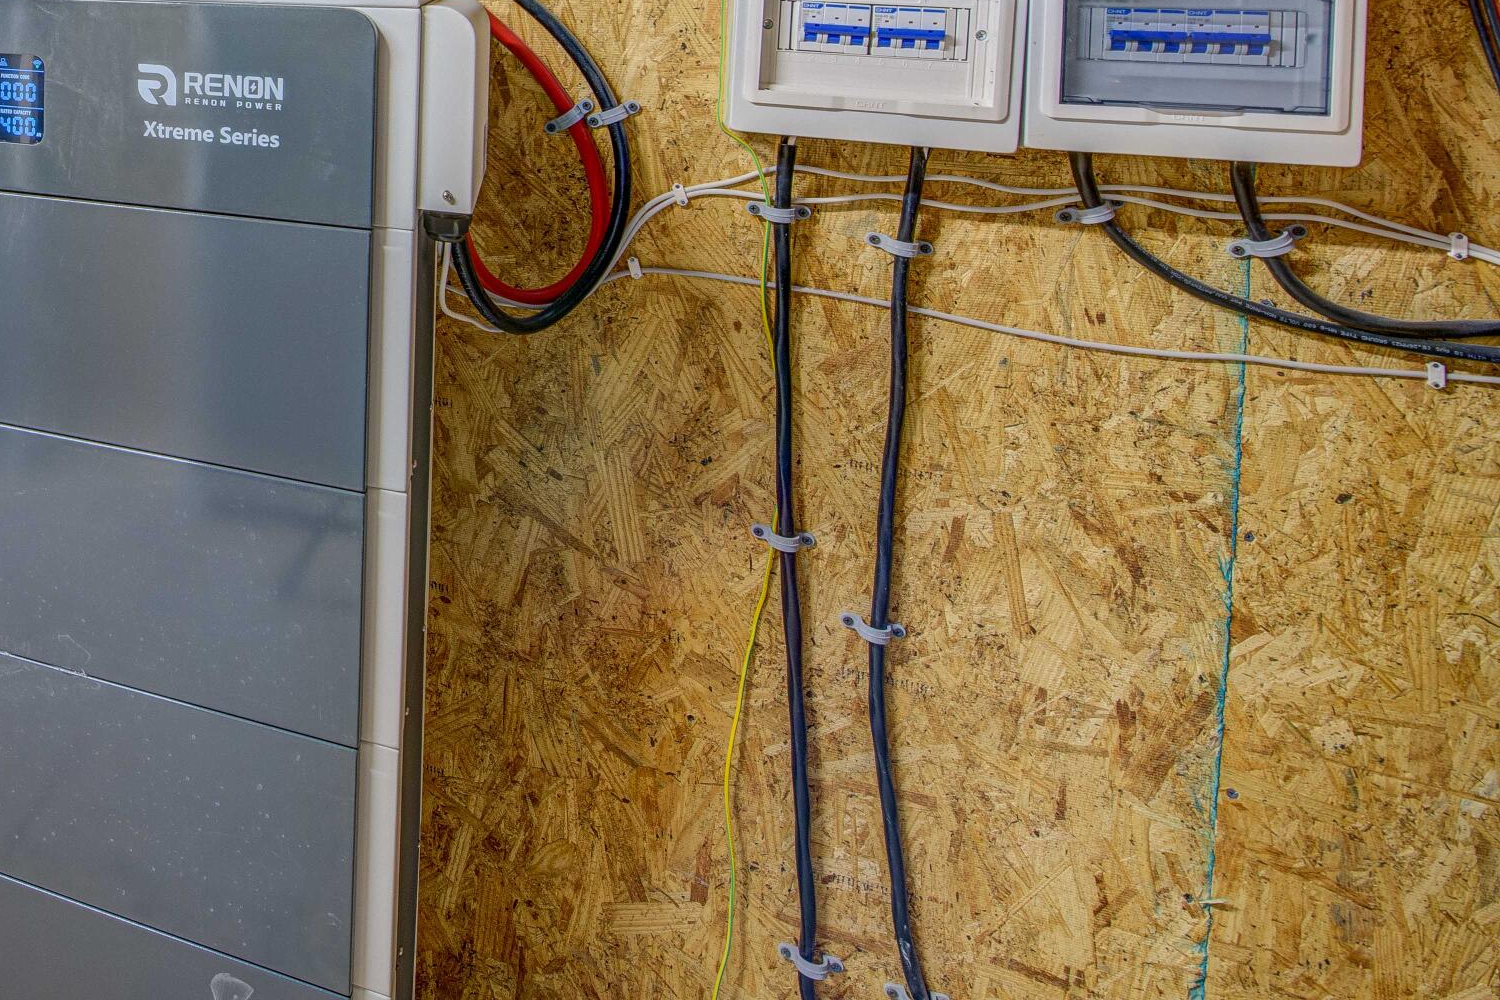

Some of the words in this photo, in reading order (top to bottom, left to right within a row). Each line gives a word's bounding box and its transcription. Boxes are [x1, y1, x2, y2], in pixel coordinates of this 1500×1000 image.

[0, 81, 37, 102] 000
[184, 71, 284, 101] RENON
[185, 97, 226, 108] RENON
[236, 101, 282, 111] POWER
[0, 116, 36, 137] 400
[143, 120, 215, 143] Xtreme
[219, 126, 280, 148] Series
[1279, 316, 1300, 326] VOLTS
[1340, 330, 1358, 339] TYPE
